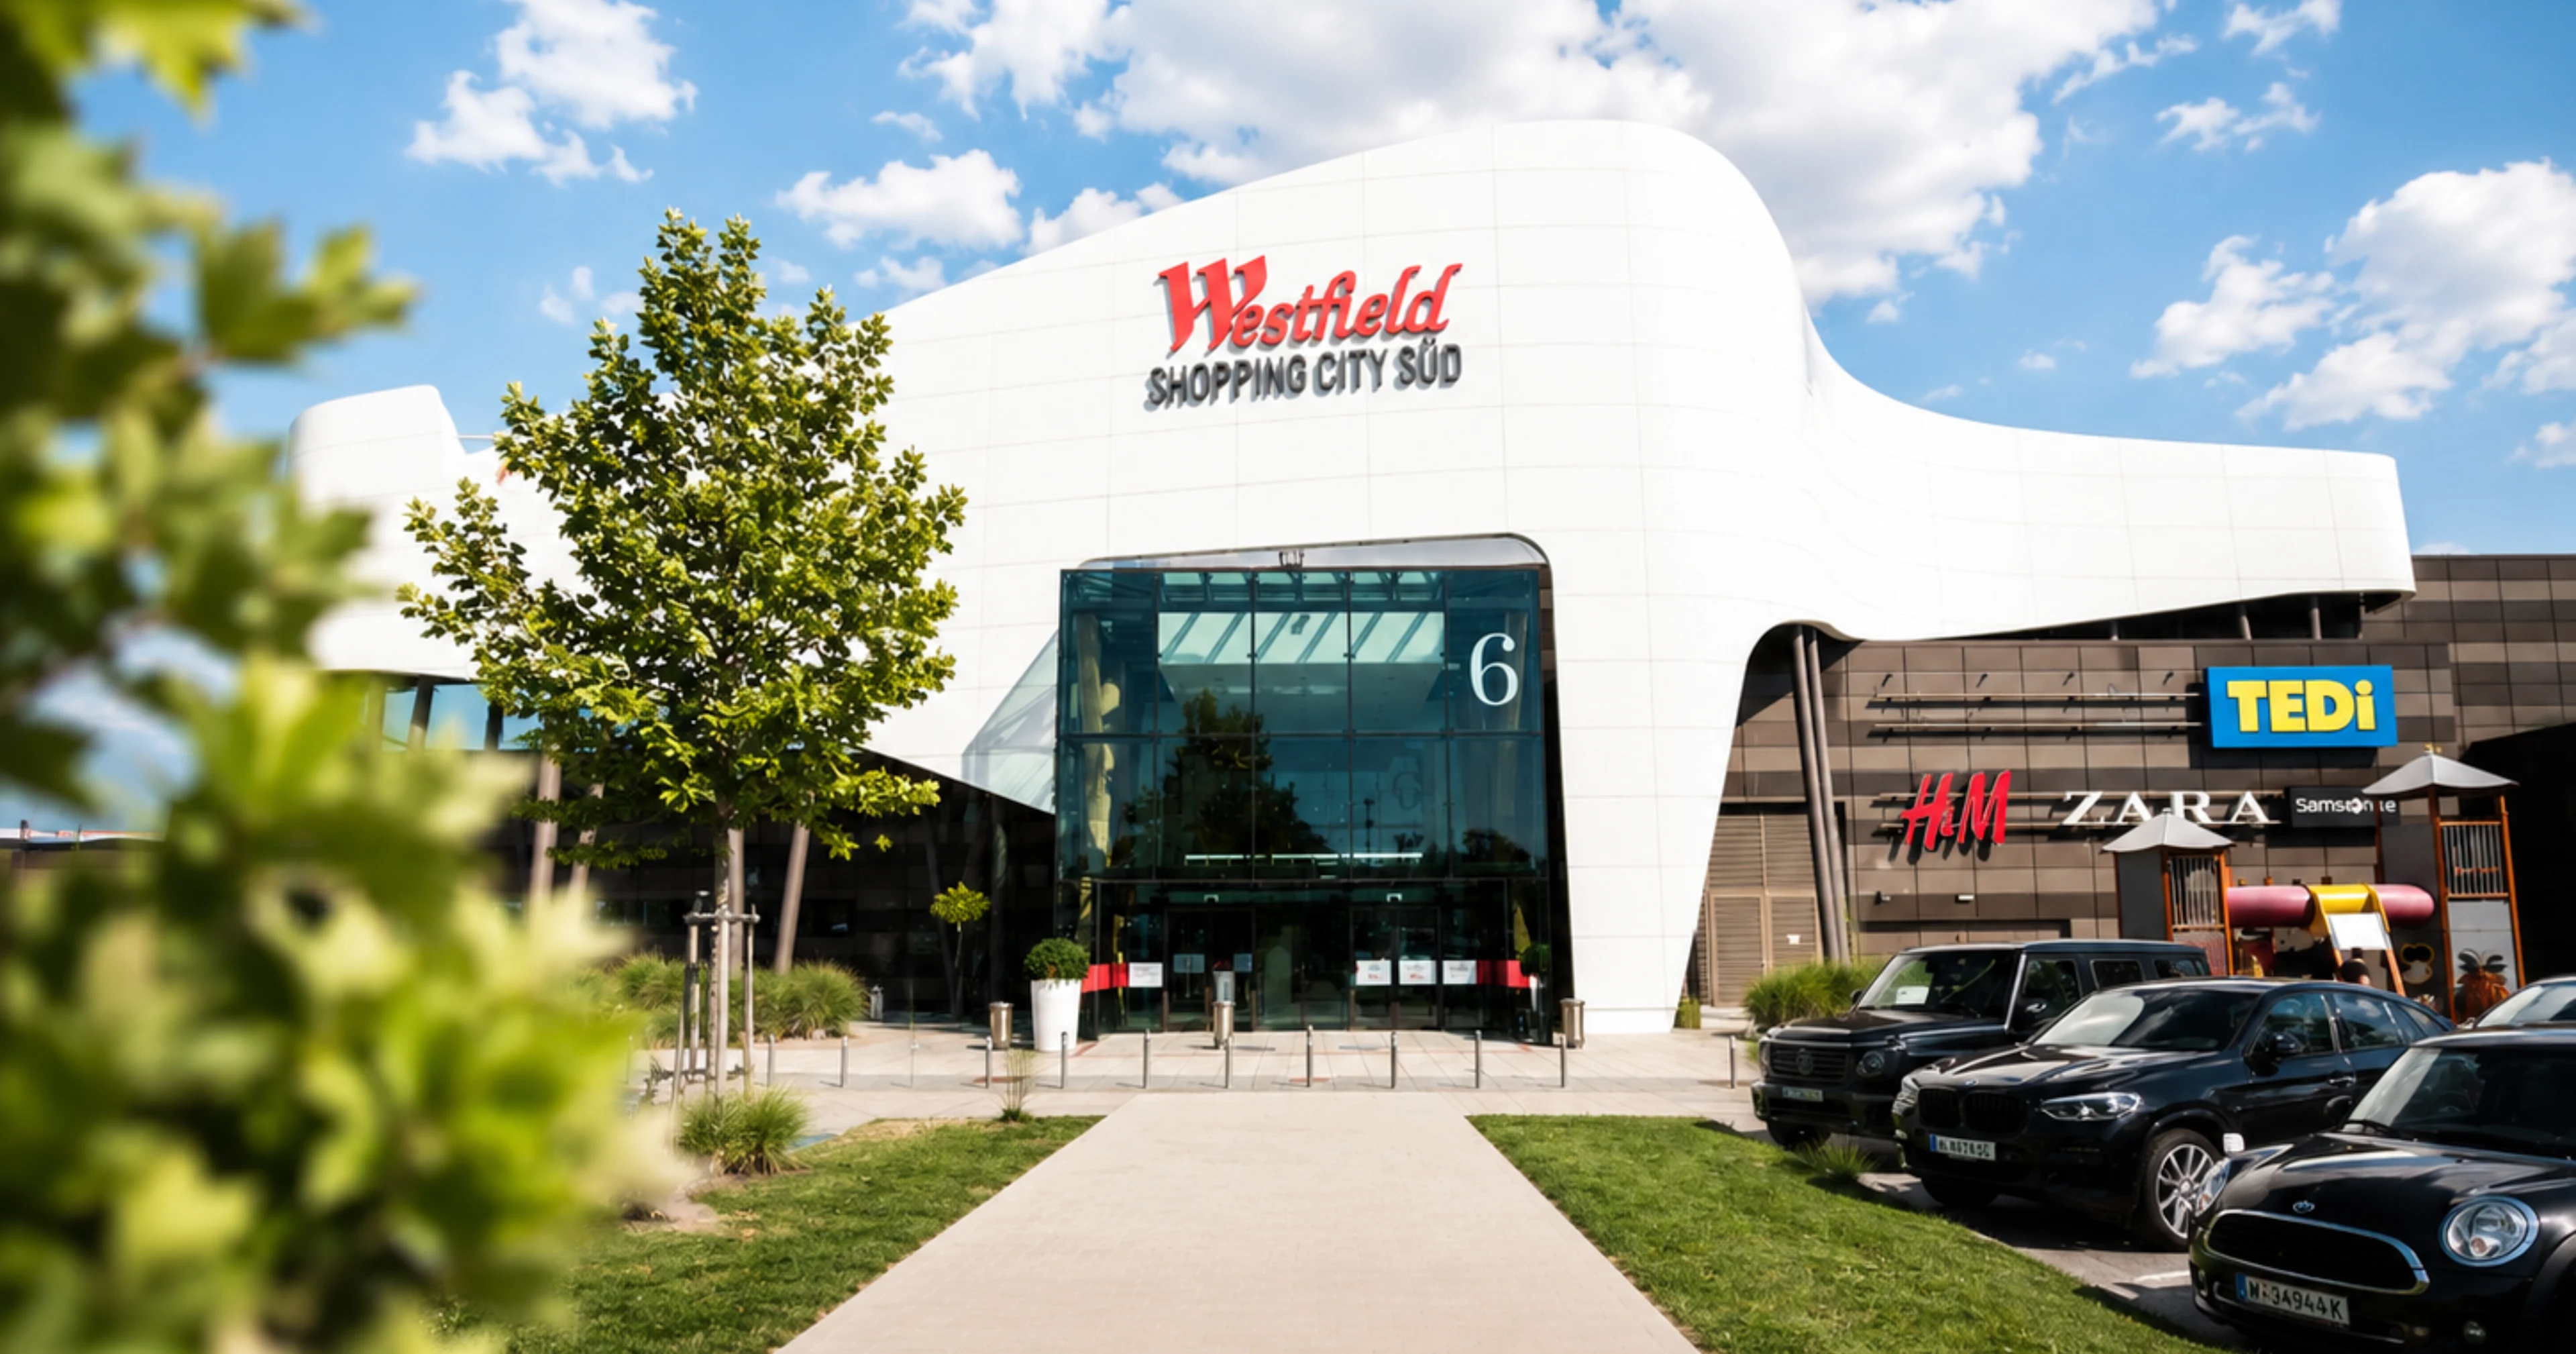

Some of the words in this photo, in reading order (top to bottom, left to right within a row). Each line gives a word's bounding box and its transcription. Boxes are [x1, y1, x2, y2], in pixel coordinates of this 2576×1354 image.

[1158, 255, 1463, 352] Westfield
[1148, 354, 1307, 406] SHOPPING
[1317, 348, 1388, 391] CITY
[1399, 337, 1462, 386] SÜD
[1470, 632, 1518, 705] 6
[2226, 679, 2376, 732] TEDi
[1900, 770, 2012, 851] H&M
[2062, 791, 2273, 824] ZARA
[2296, 796, 2397, 815] Samsonte
